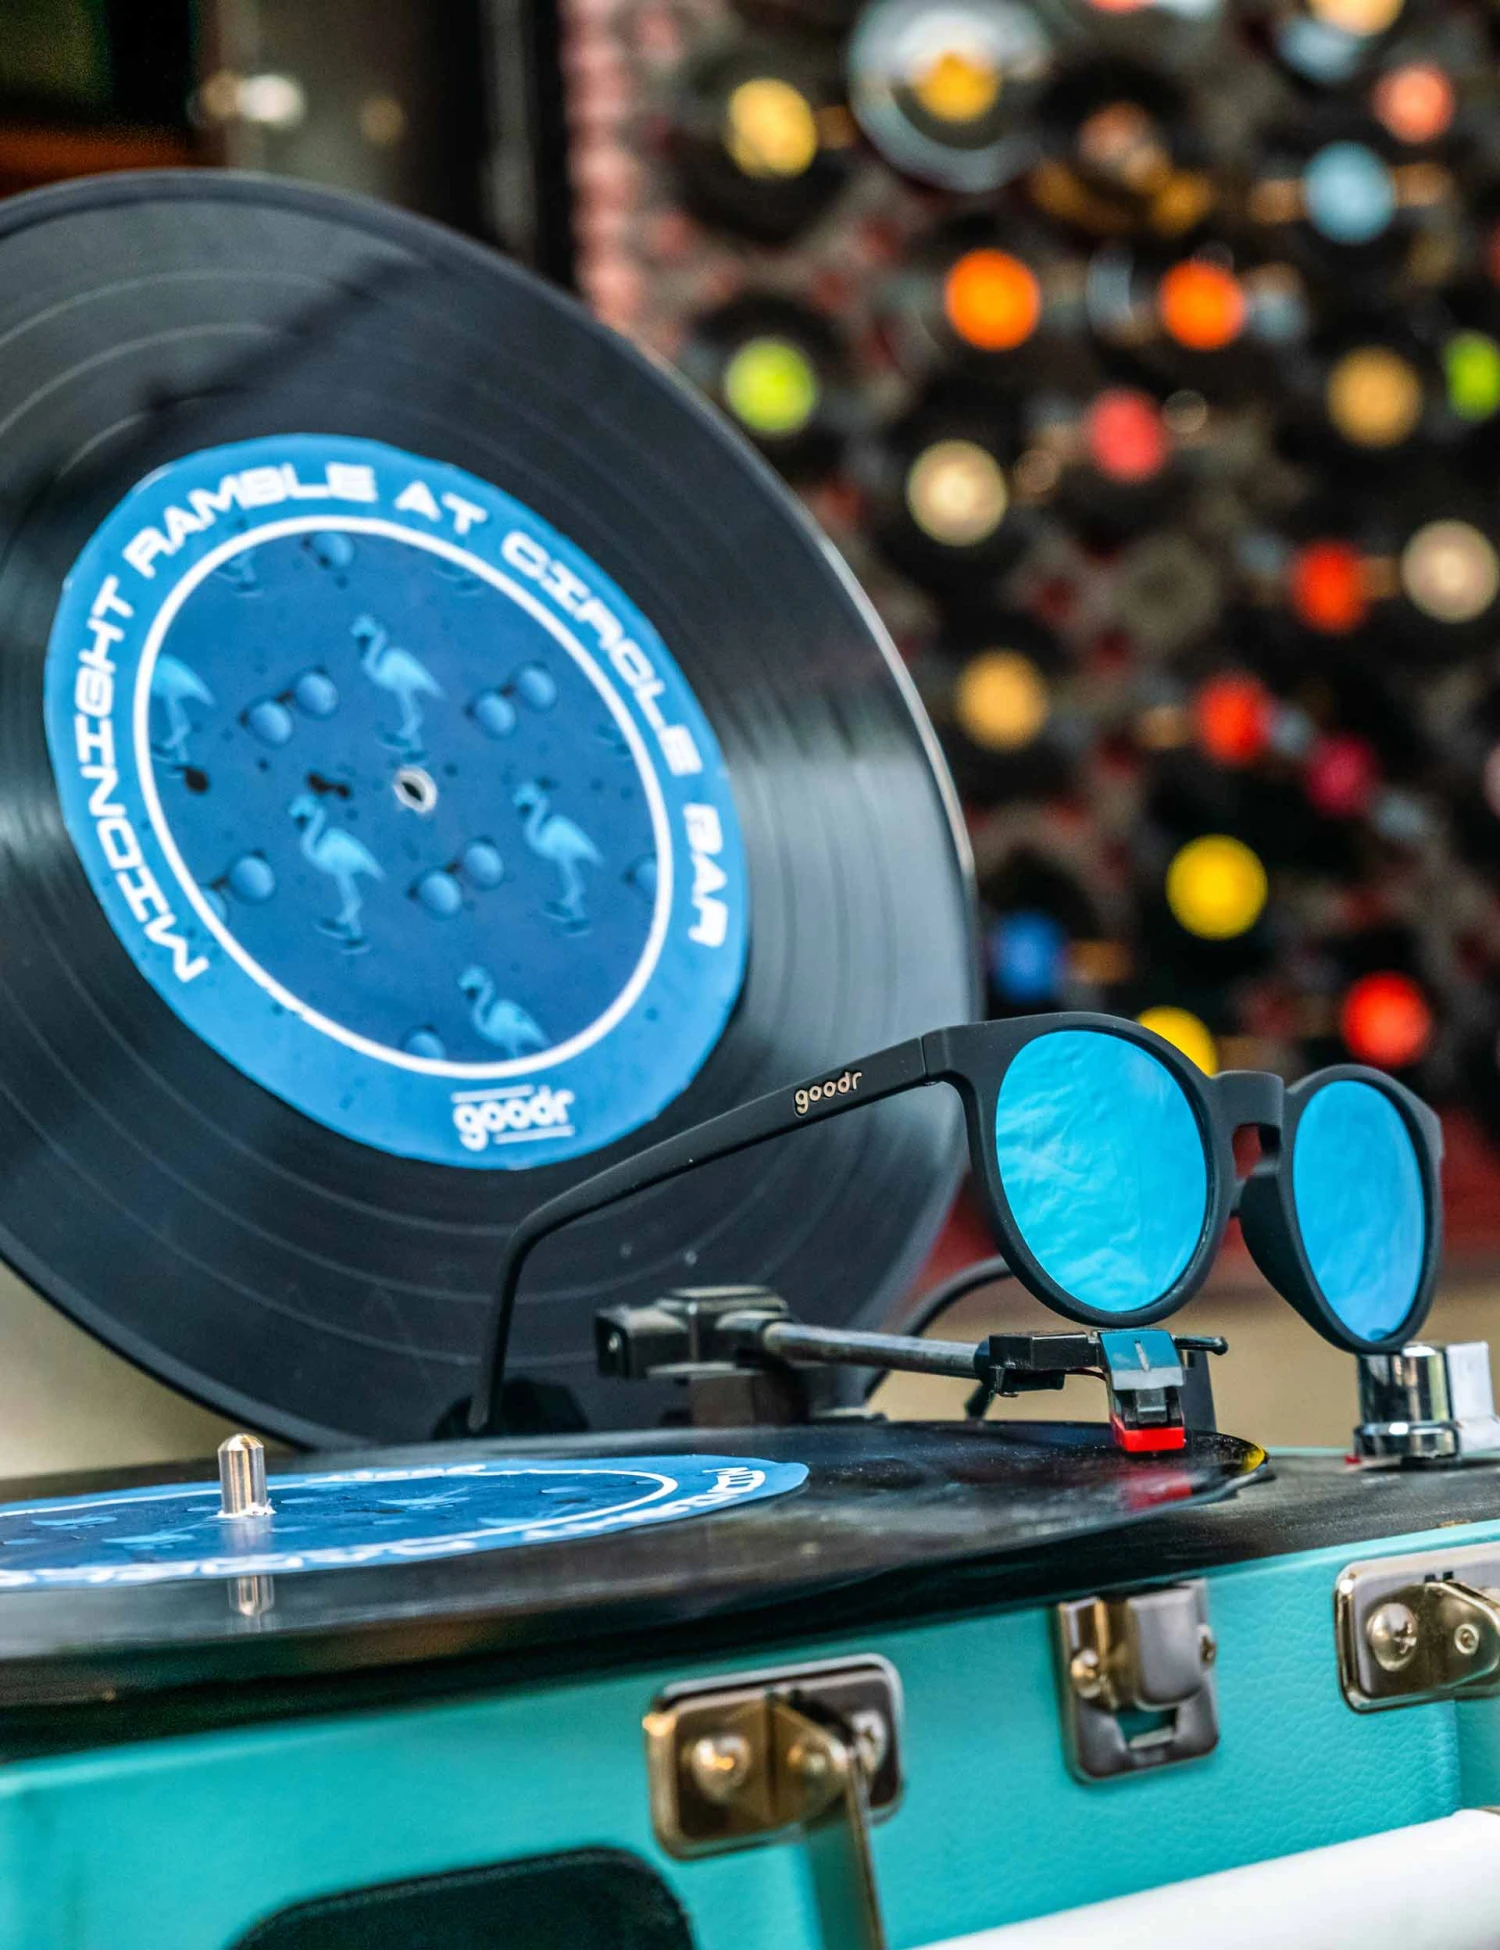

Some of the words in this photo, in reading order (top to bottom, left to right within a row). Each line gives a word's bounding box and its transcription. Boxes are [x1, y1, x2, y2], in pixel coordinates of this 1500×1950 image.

[122, 462, 379, 579] RAMBLE
[394, 480, 487, 535] AT
[501, 531, 704, 777] CIRCLE
[74, 575, 209, 982] MIDNIGHT
[682, 802, 729, 949] BAR
[453, 1084, 575, 1151] goodr
[795, 1071, 862, 1114] goodr
